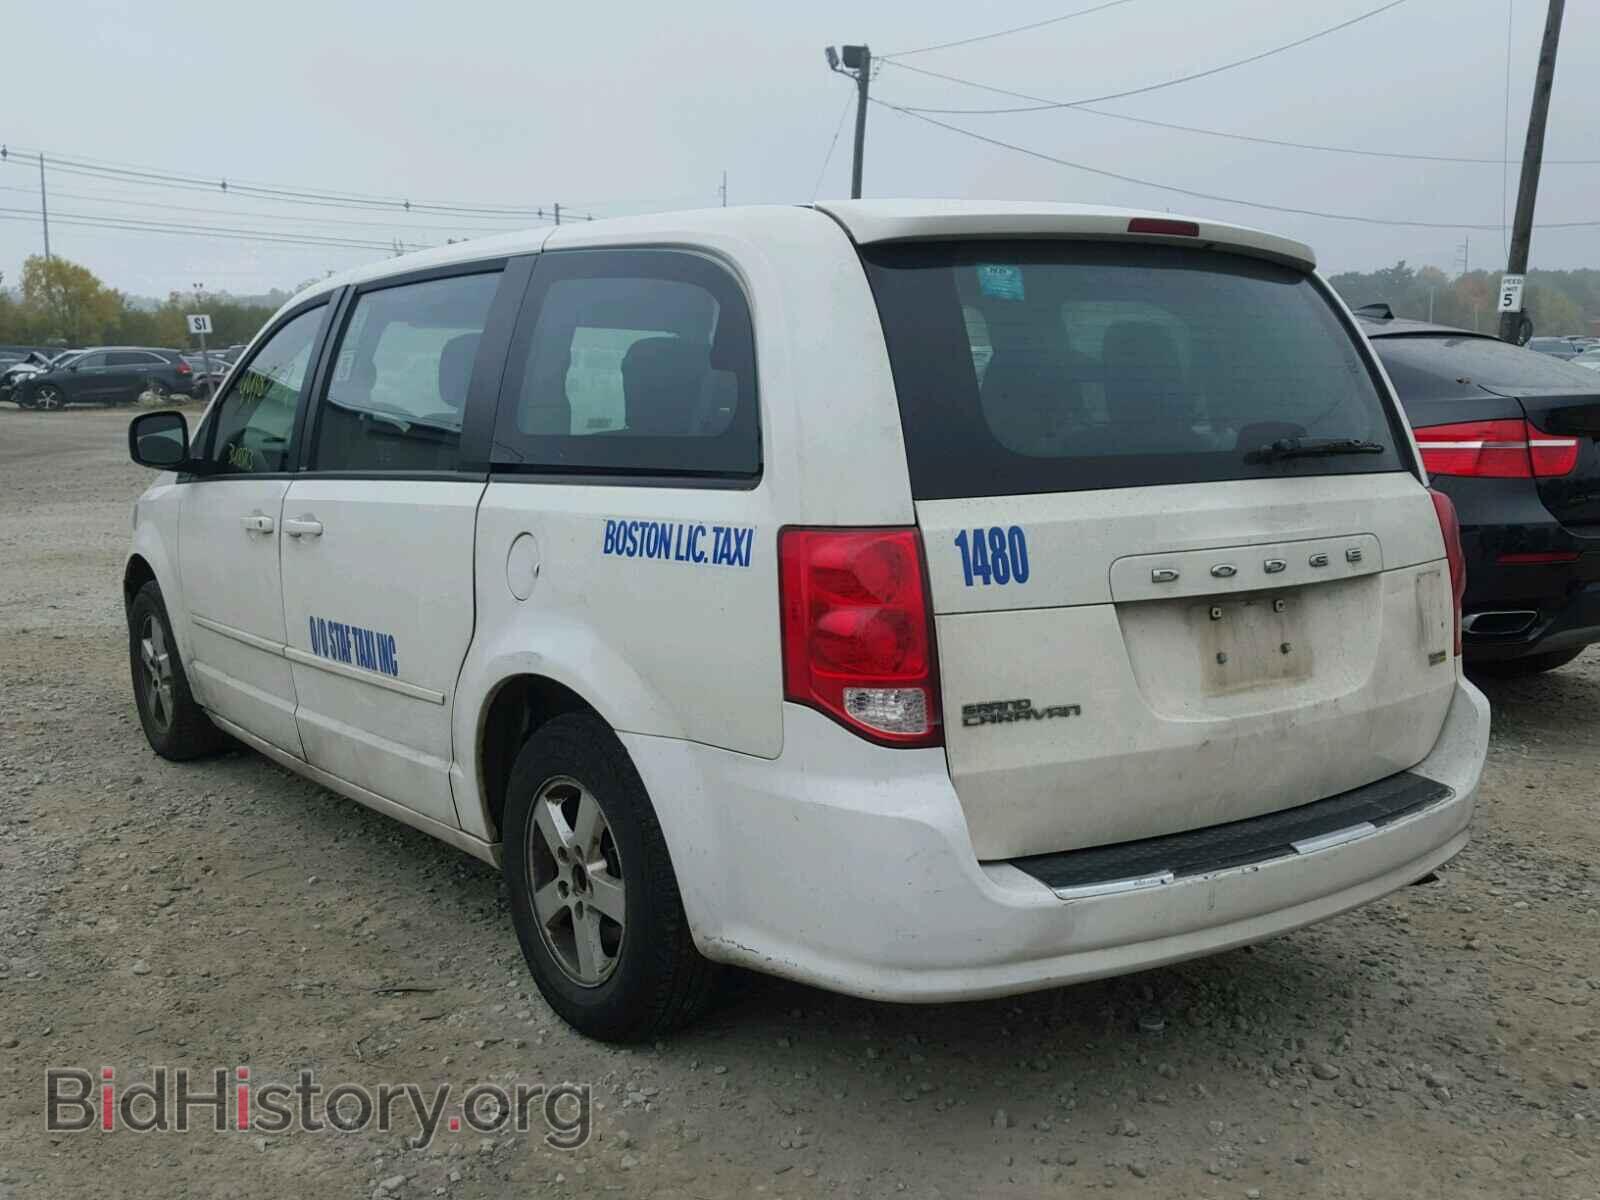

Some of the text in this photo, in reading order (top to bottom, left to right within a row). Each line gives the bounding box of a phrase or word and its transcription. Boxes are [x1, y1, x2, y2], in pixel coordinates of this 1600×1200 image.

[1503, 293, 1513, 307] 5
[603, 519, 754, 567] BOSTON LIC. TAXI
[954, 525, 1030, 587] 1480
[1151, 548, 1362, 583] DODGE
[351, 626, 378, 671] TAXI
[375, 632, 399, 676] INC
[961, 698, 1032, 716] GRAND
[961, 704, 1082, 727] CARAVAN
